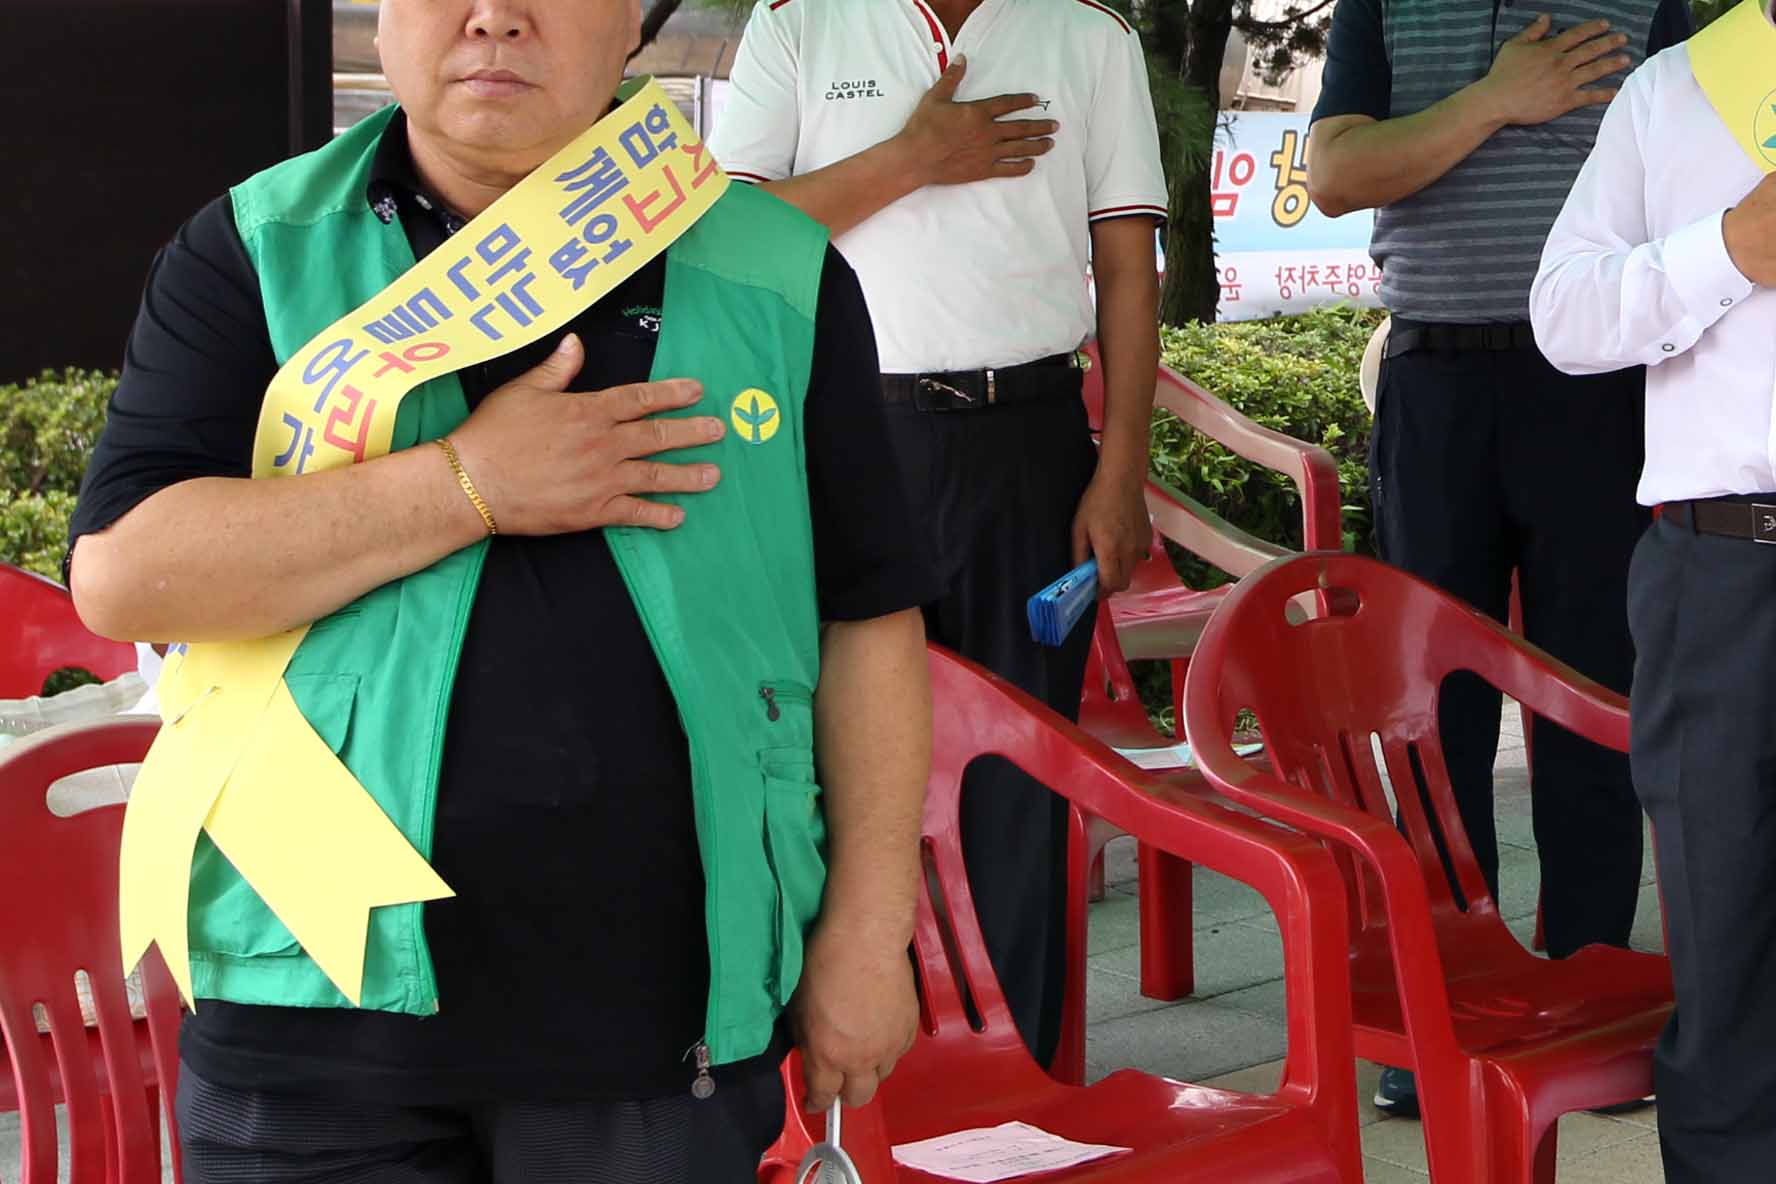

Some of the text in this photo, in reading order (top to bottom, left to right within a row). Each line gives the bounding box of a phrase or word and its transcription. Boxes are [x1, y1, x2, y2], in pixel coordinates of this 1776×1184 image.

[831, 79, 877, 91] LOUIS
[825, 89, 885, 101] CASTEL
[553, 101, 680, 228] 함께
